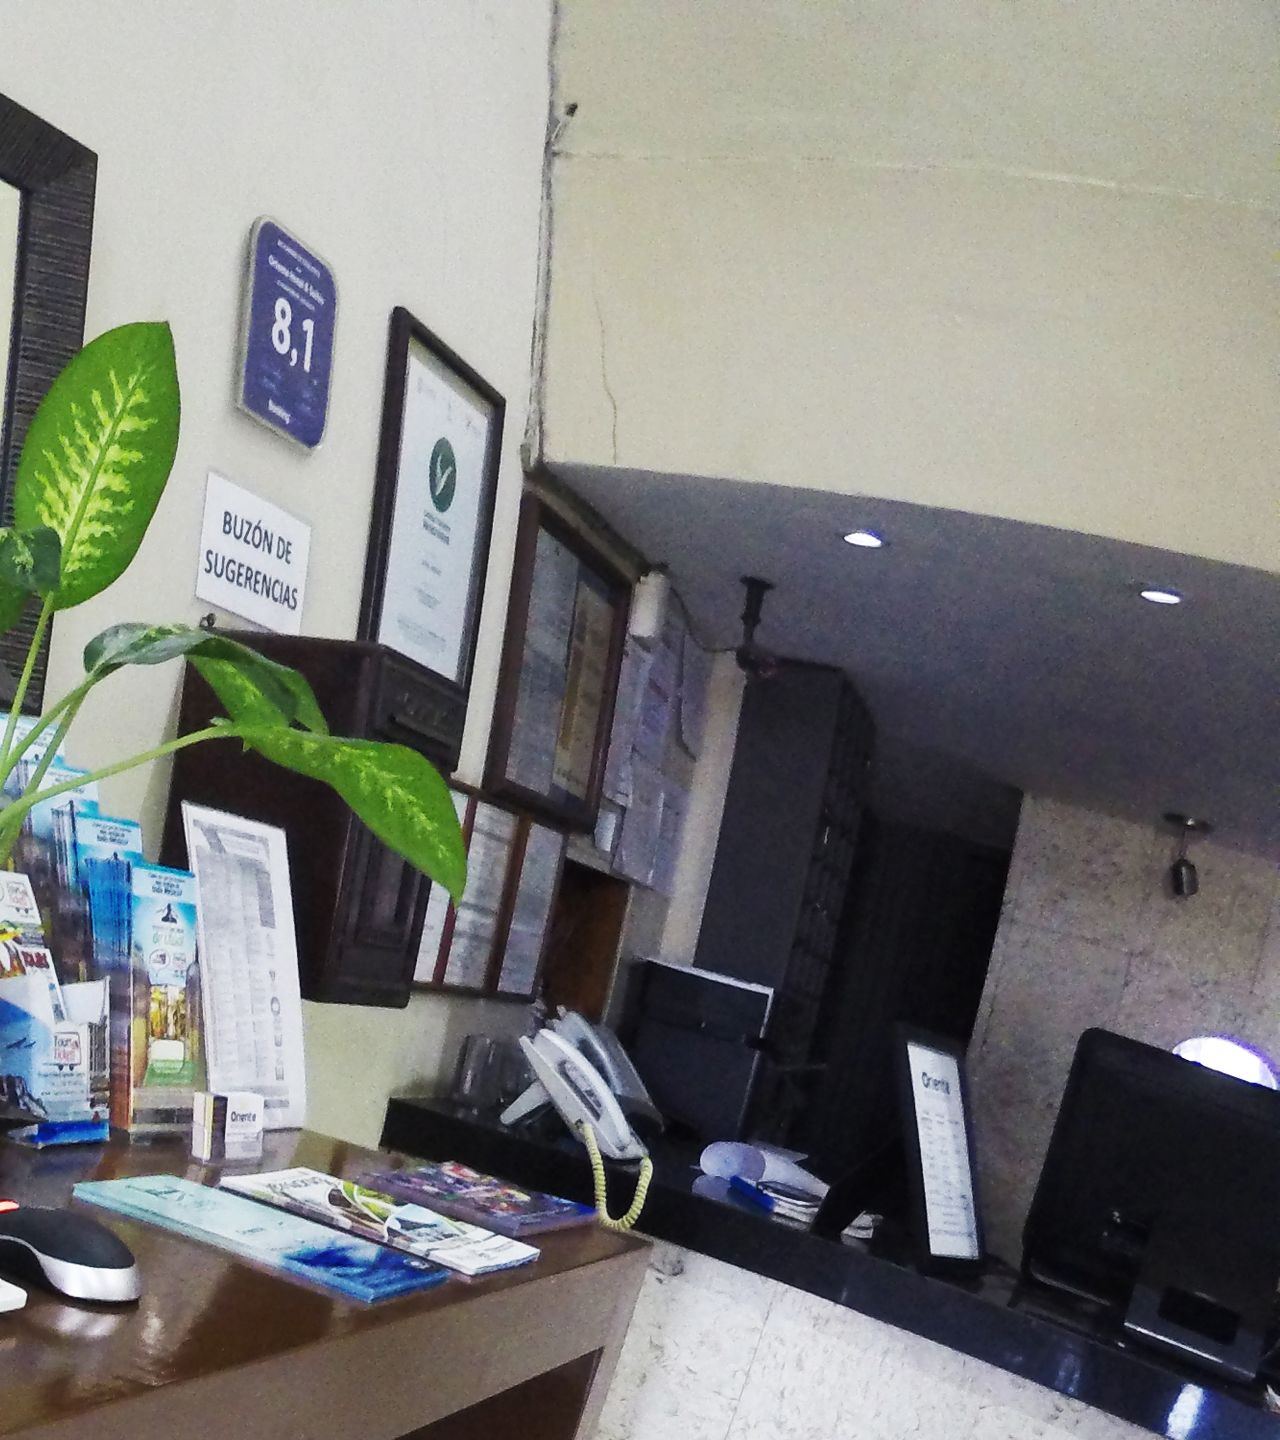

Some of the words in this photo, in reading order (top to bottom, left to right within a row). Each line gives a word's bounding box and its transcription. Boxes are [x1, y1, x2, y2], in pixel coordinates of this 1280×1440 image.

[271, 297, 314, 373] 8,1
[223, 510, 273, 554] BUZÓN
[276, 535, 292, 564] DE
[204, 549, 297, 610] SUGERENCIAS
